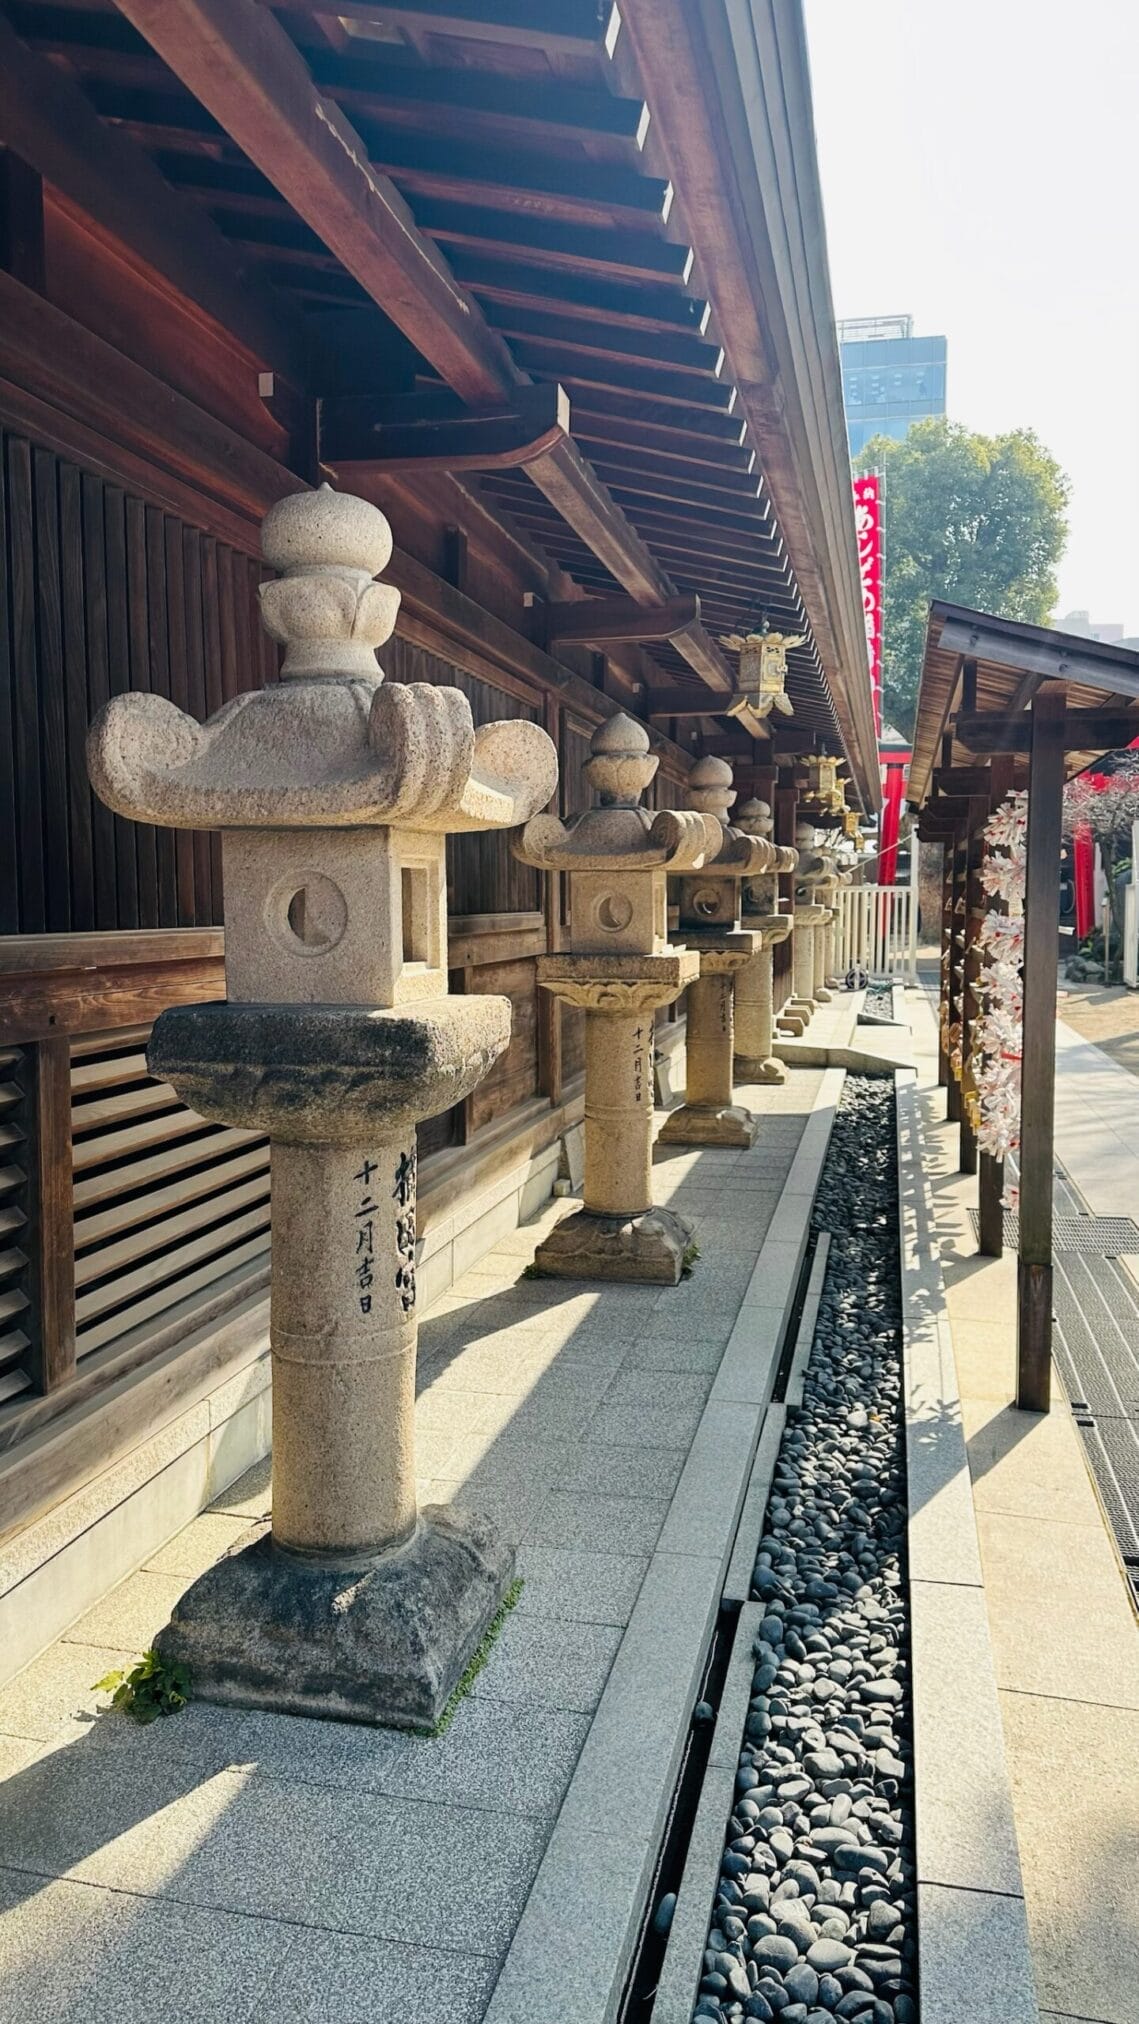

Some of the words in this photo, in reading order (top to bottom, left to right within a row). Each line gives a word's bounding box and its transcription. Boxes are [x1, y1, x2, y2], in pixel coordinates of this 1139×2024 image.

[632, 1026, 644, 1101] 十二月吉日
[353, 1160, 379, 1314] 十二月吉日
